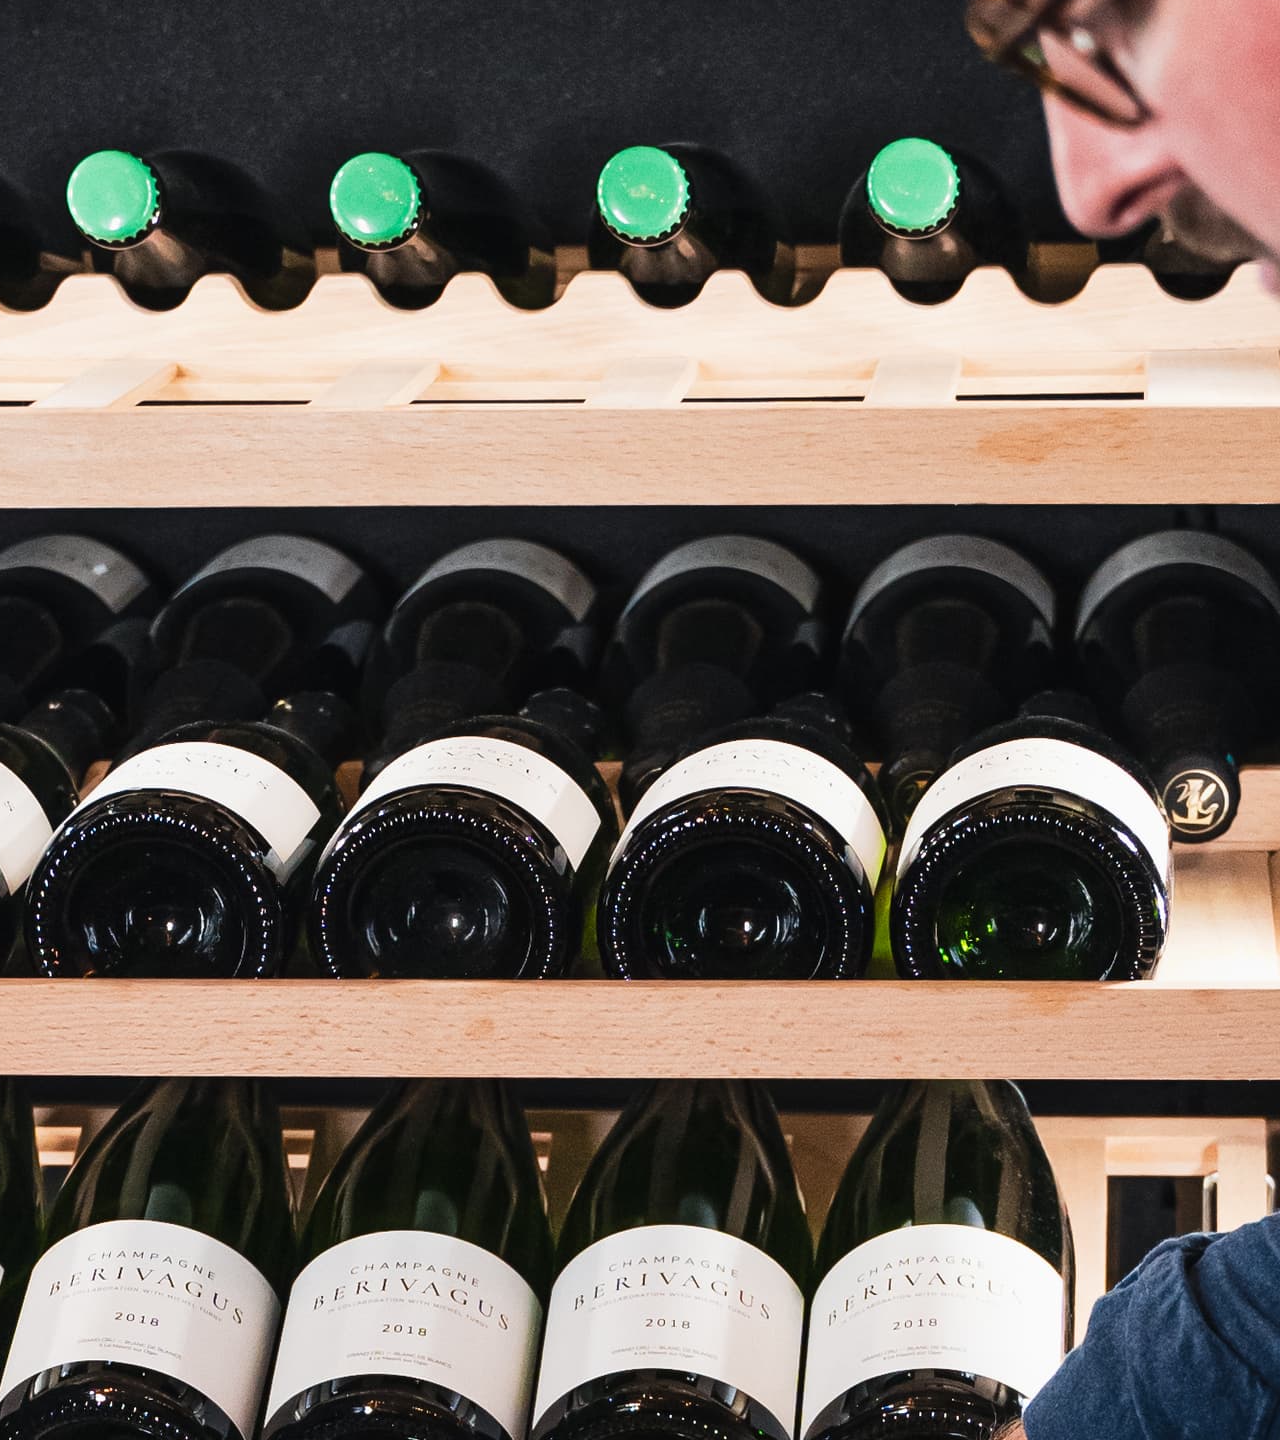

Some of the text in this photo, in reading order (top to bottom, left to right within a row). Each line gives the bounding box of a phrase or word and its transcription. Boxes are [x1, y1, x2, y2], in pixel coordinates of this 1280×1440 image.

[87, 1250, 217, 1281] CHAMPAGNE
[349, 1261, 481, 1289] CHAMPAGNE
[608, 1255, 740, 1279] CHAMPAGNE
[48, 1266, 244, 1325] BERIVAGUS
[312, 1277, 510, 1331] BERIVAGUS
[573, 1271, 771, 1321] BERIVAGUS
[114, 1311, 160, 1327] 2018
[381, 1323, 428, 1337] 2018
[645, 1318, 691, 1330] 2018
[892, 1318, 938, 1331] 2018
